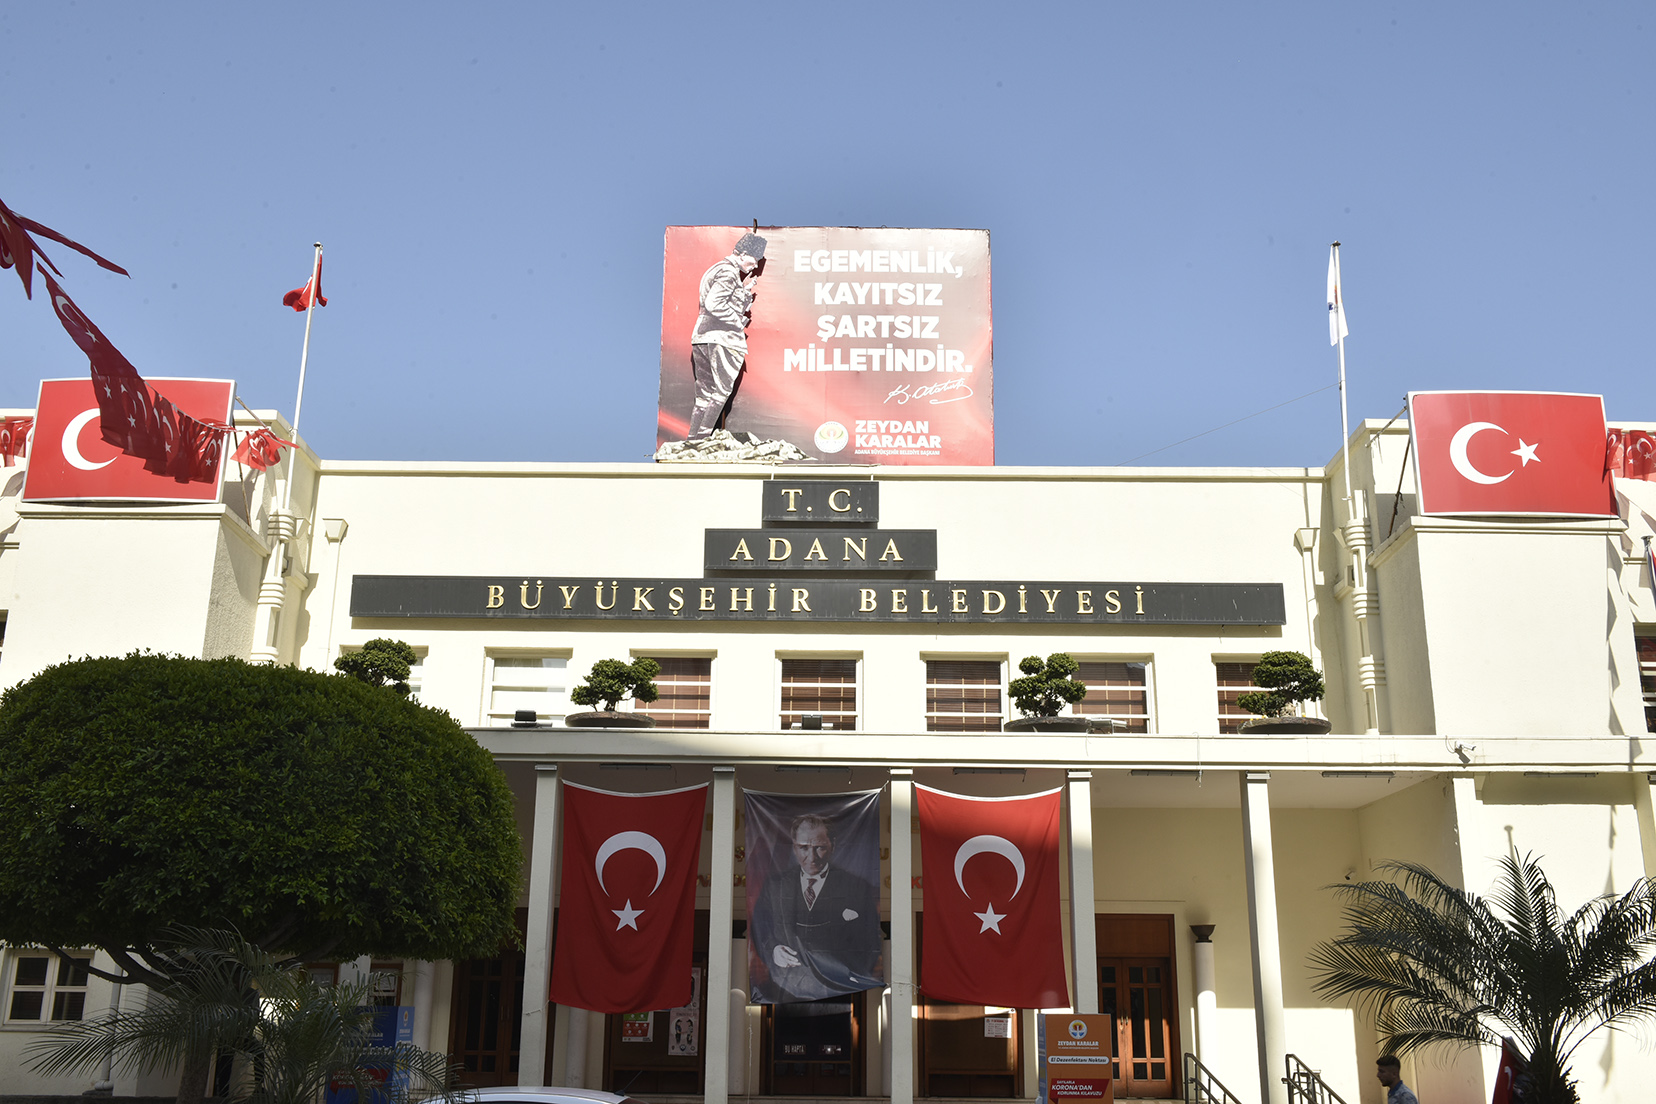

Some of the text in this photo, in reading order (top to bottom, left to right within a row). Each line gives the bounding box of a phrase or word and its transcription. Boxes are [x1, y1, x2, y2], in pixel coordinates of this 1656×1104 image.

[794, 246, 963, 278] EGEMENLİK,
[814, 282, 943, 306] KAYITSIZ
[817, 314, 940, 342] ŞARTSIZ
[783, 343, 973, 373] MİLLETİNDİR.
[855, 420, 929, 434] ZEYDAN
[855, 434, 942, 448] KARALAR
[729, 537, 904, 562] ADANA
[486, 580, 1146, 616] BÜYÜKŞEHİR BELEDİYESİ
